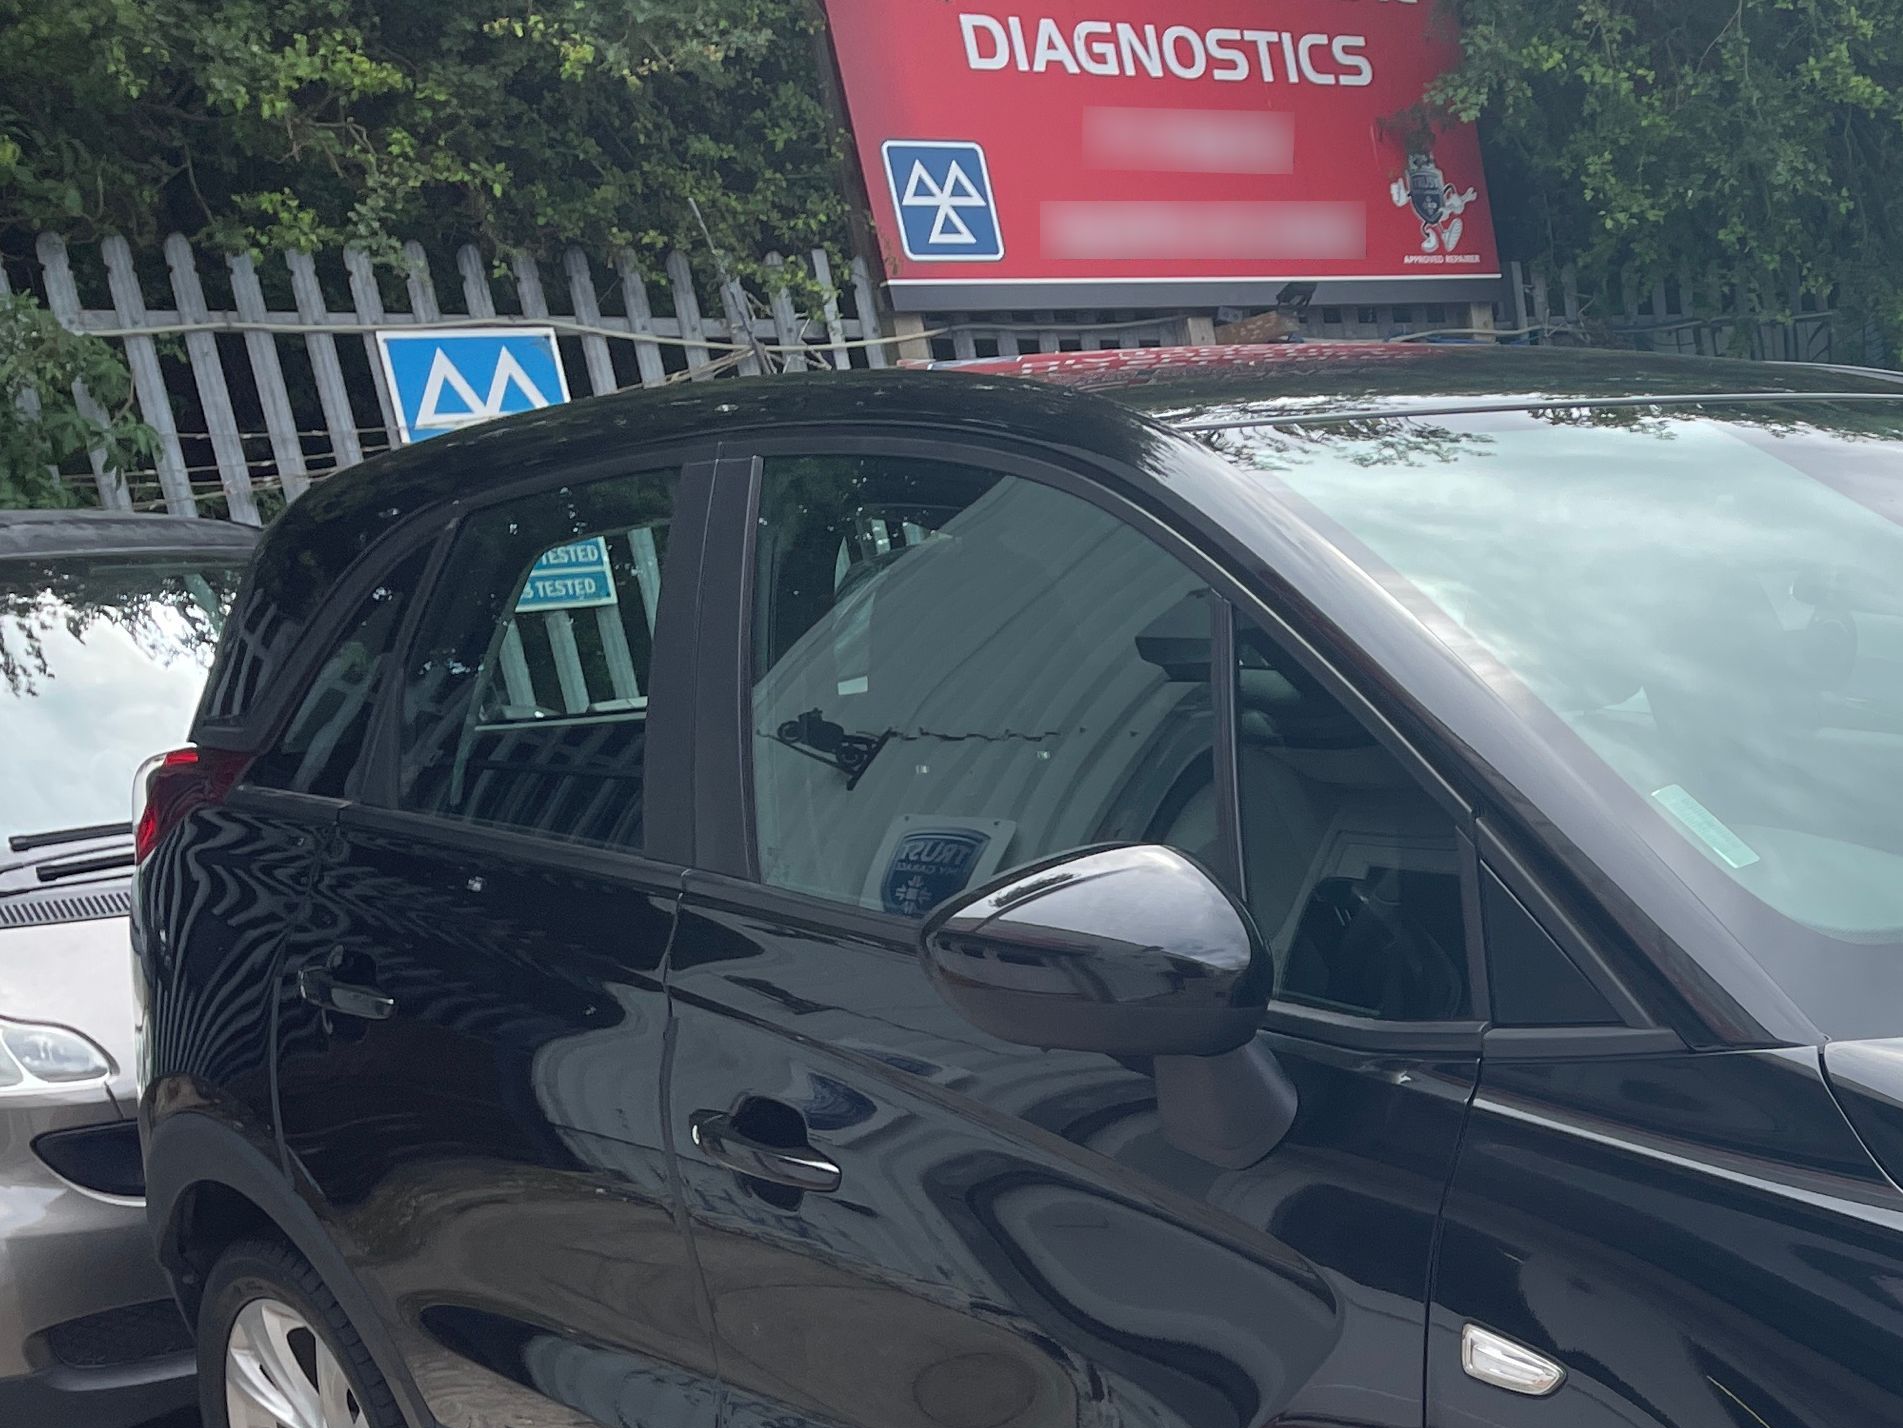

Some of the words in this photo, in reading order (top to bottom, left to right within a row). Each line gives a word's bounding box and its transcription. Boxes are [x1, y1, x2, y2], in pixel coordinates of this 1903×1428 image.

[959, 13, 1373, 87] DIAGNOSTICS
[541, 544, 599, 566] TESTED
[535, 578, 596, 599] TESTED
